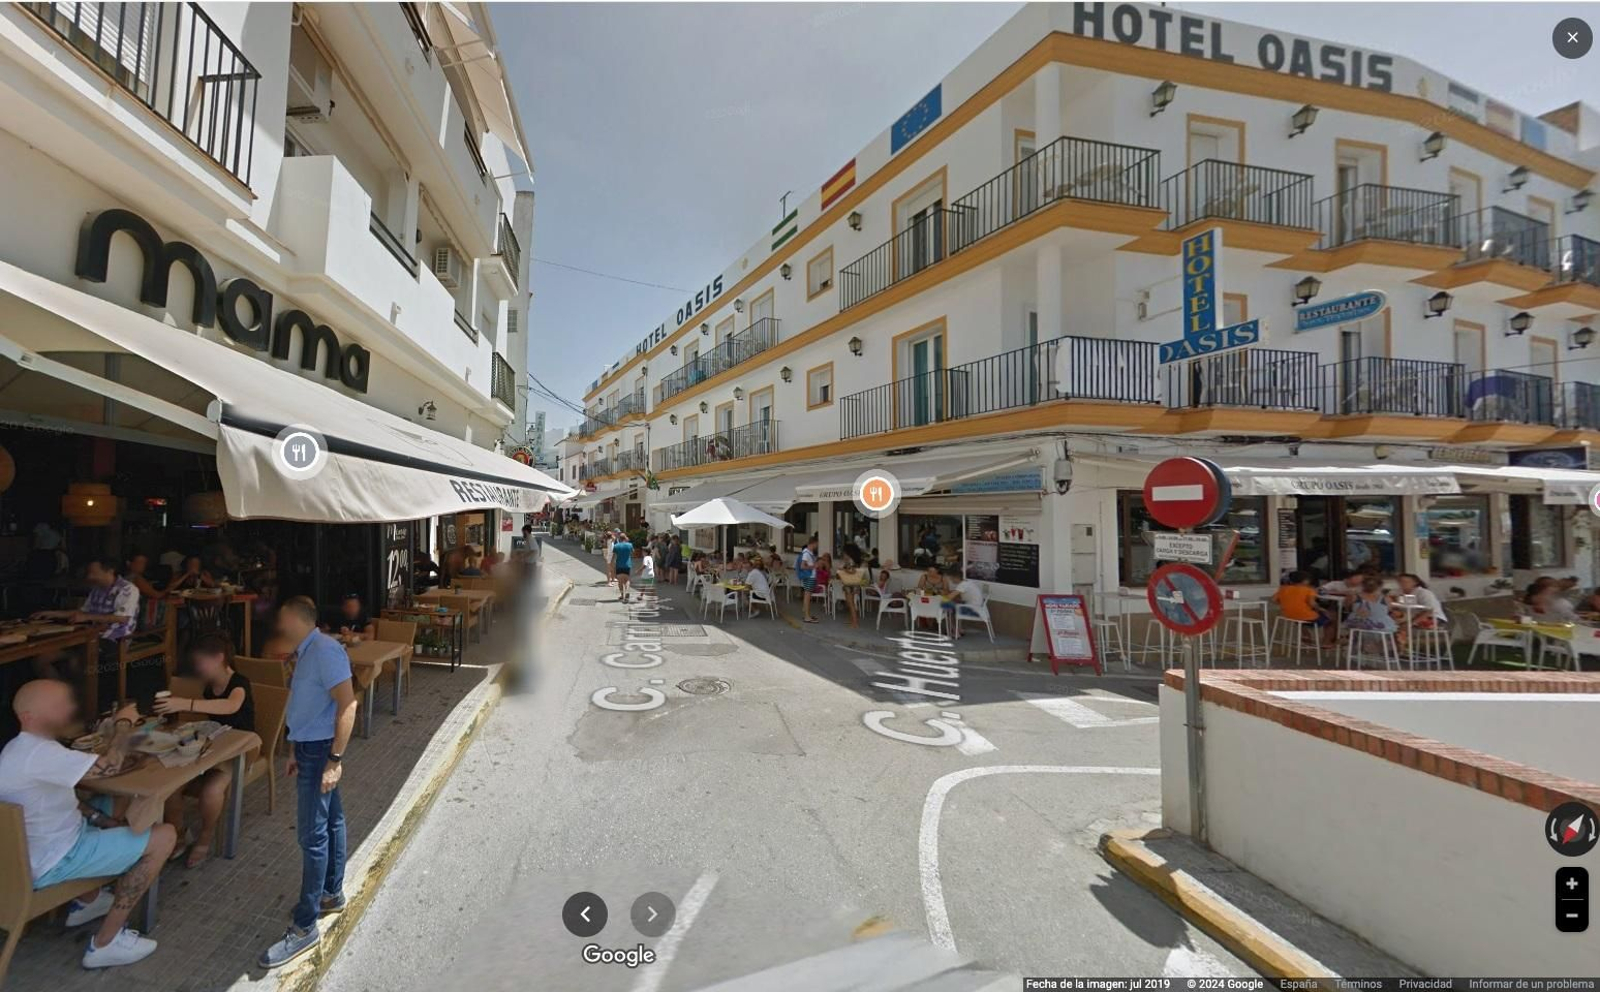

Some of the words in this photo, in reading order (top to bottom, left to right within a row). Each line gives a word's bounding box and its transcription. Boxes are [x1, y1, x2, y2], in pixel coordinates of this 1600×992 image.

[1073, 2, 1234, 64] HOTEL
[1257, 33, 1394, 94] OASIS
[75, 208, 371, 394] mama
[635, 322, 668, 357] HOTEL
[676, 273, 724, 326] OASIS
[1186, 231, 1213, 333] HOTEL
[1298, 294, 1379, 322] RESTAURANTE
[449, 479, 519, 508] RESTAURANTE
